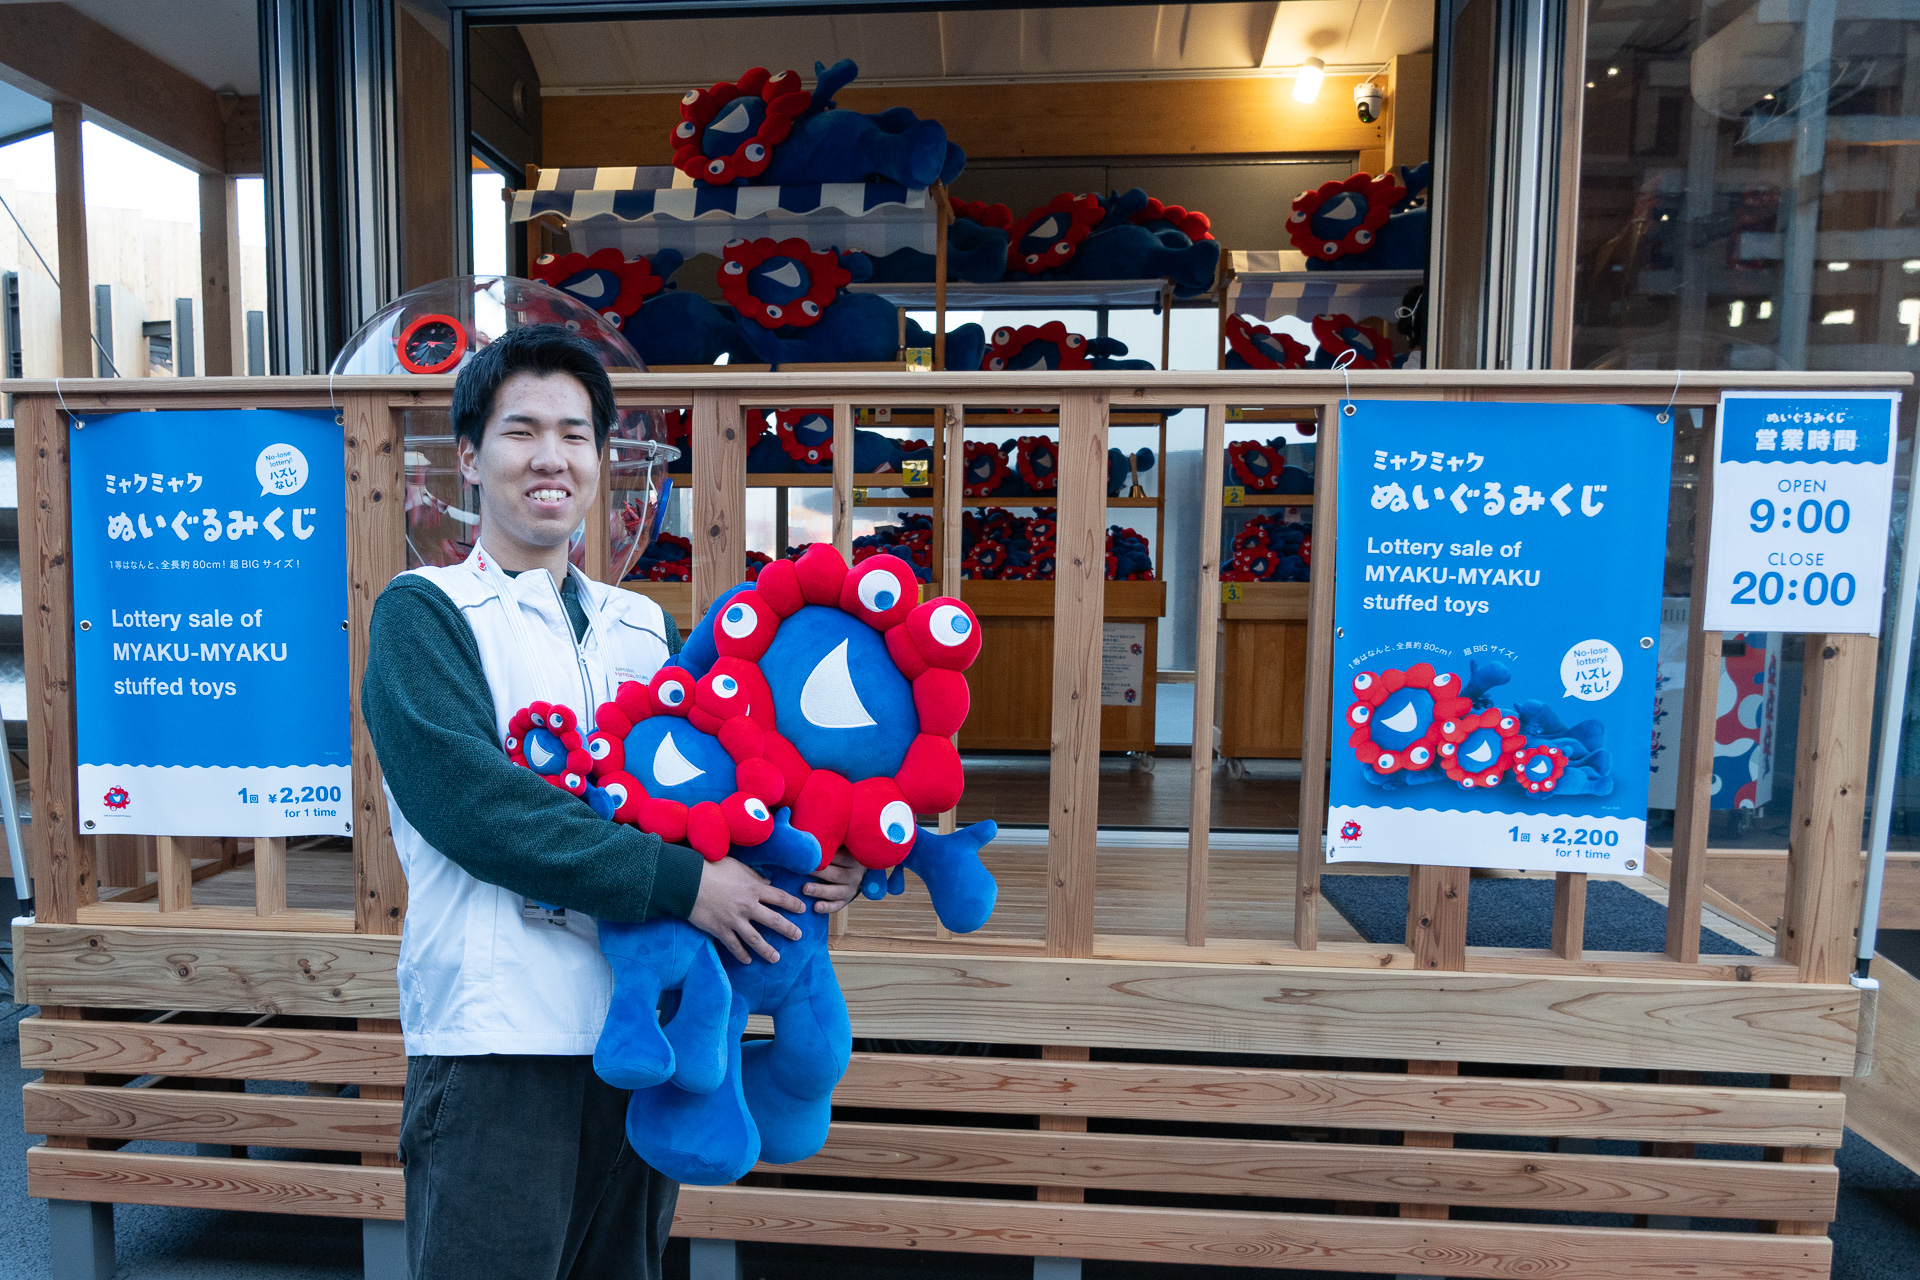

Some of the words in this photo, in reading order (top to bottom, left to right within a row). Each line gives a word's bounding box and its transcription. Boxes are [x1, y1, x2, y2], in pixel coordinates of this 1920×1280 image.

[1755, 428, 1858, 451] 営業時間
[265, 451, 292, 461] No-lose
[269, 457, 293, 468] lottery!
[1373, 449, 1485, 473] ミャクミャク
[105, 472, 203, 495] ミャクミャク
[270, 467, 297, 480] ハズレ
[1777, 479, 1827, 493] OPEN
[1370, 481, 1608, 518] ぬいぐるみくじ
[107, 506, 316, 543] ぬいぐるみくじ
[1749, 498, 1851, 535] 9:00
[1367, 536, 1444, 560] Lottery
[1449, 539, 1494, 557] sale
[1499, 541, 1523, 558] of
[1767, 552, 1824, 567] CLOSE
[1365, 564, 1541, 587] MYAKU-MYAKU
[1730, 570, 1857, 607] 20:00
[1362, 593, 1438, 612] stuffed
[1443, 596, 1490, 617] toys
[111, 609, 182, 632] Lottery
[188, 608, 234, 628] sale
[240, 608, 263, 628] of
[113, 642, 288, 662] MYAKU-MYAKU
[1573, 647, 1609, 658] No-lose
[1576, 655, 1608, 667] lottery!
[1575, 667, 1611, 682] ハズレ
[114, 677, 183, 696] stuffed
[189, 678, 237, 700] toys
[237, 787, 259, 804] 1回
[268, 785, 342, 805] ¥2,200
[284, 808, 301, 818] for
[313, 807, 337, 817] time
[1508, 825, 1531, 843] 1回
[1540, 826, 1619, 847] ¥2,200
[1555, 847, 1572, 858] for
[1575, 849, 1581, 858] 1
[1585, 849, 1611, 860] time
